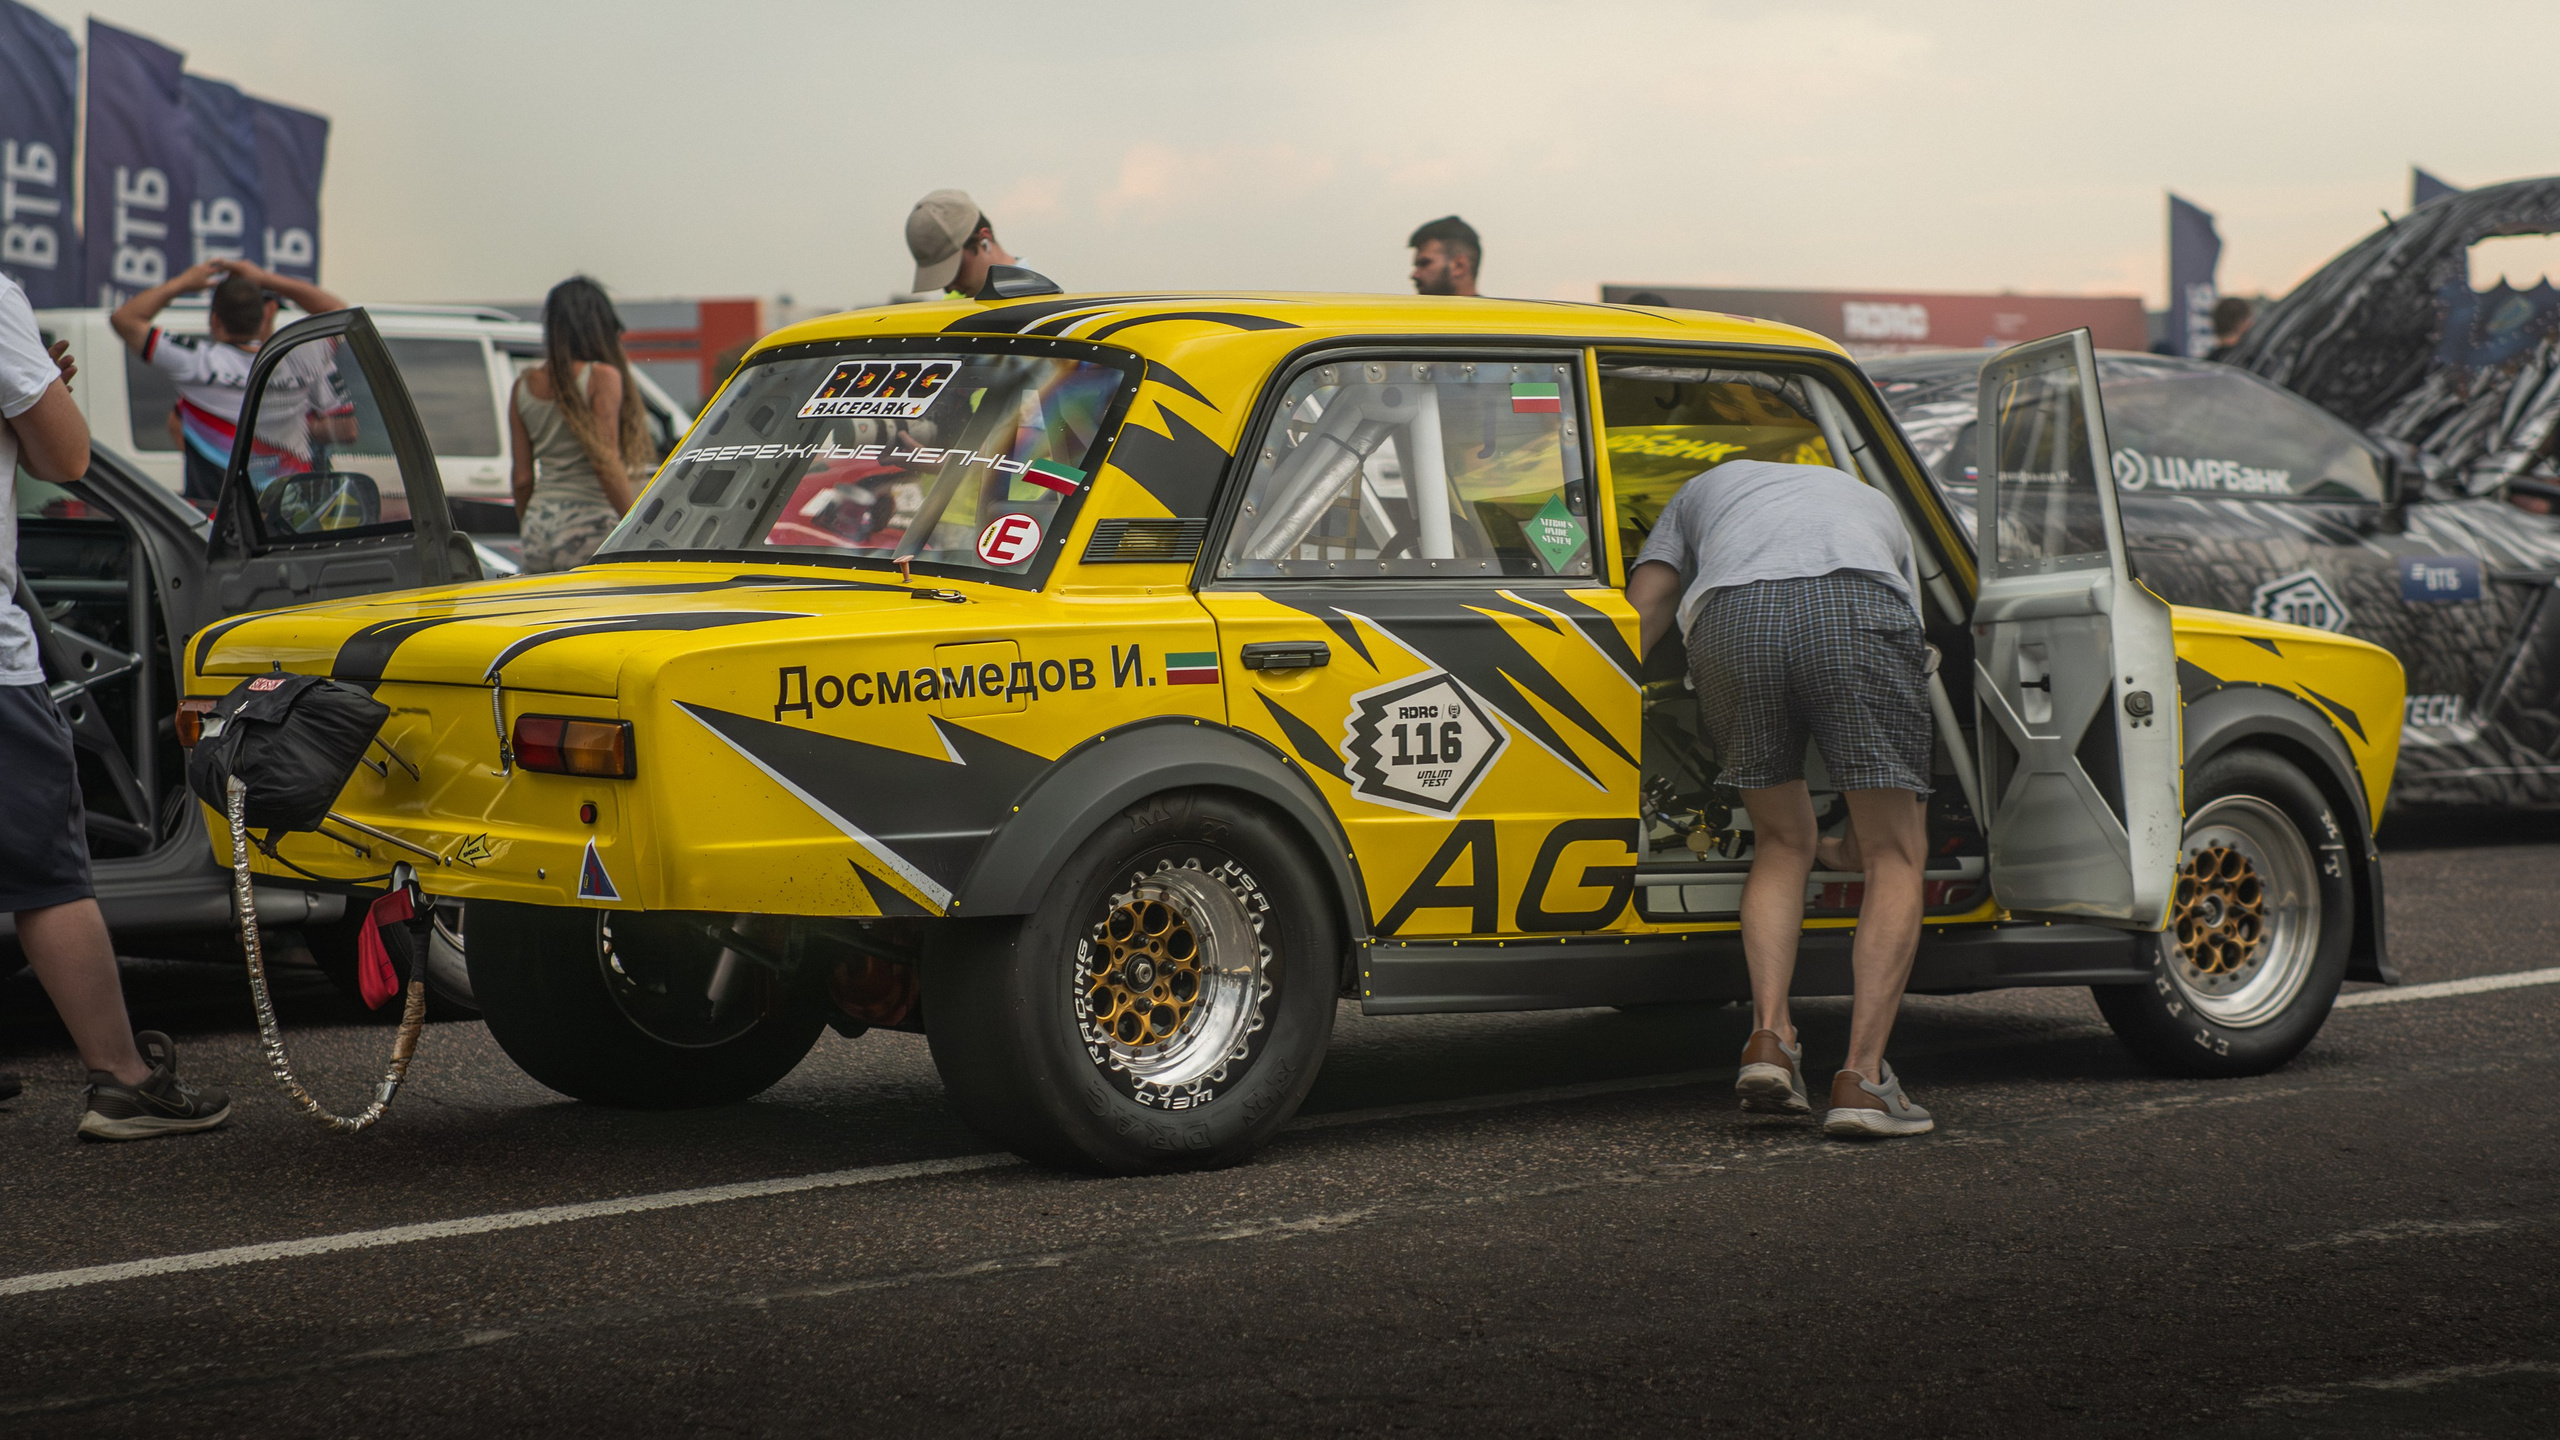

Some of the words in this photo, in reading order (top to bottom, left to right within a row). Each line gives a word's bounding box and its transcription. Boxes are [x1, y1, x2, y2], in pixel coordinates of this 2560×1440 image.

[1, 138, 60, 271] ВТБ
[110, 164, 170, 287] ВТБ
[814, 363, 953, 399] RDRC
[812, 402, 911, 415] RACEPARK
[890, 446, 1033, 475] ЧЕЛНЫ
[2153, 455, 2294, 495] ЦМРБанк
[1540, 517, 1574, 529] NITROUS
[1544, 527, 1568, 537] OXIDE
[986, 518, 1032, 561] E
[1541, 534, 1572, 546] SYSTEM
[774, 657, 1098, 723] Досмамедов
[1110, 643, 1157, 689] И.
[1399, 706, 1439, 720] RDRC
[1391, 721, 1462, 766] 116
[1417, 769, 1453, 780] UNLIM
[1422, 778, 1449, 788] FEST
[1223, 859, 1270, 913] USA
[1074, 937, 1106, 1066] RACING
[1133, 1087, 1214, 1111] WELD
